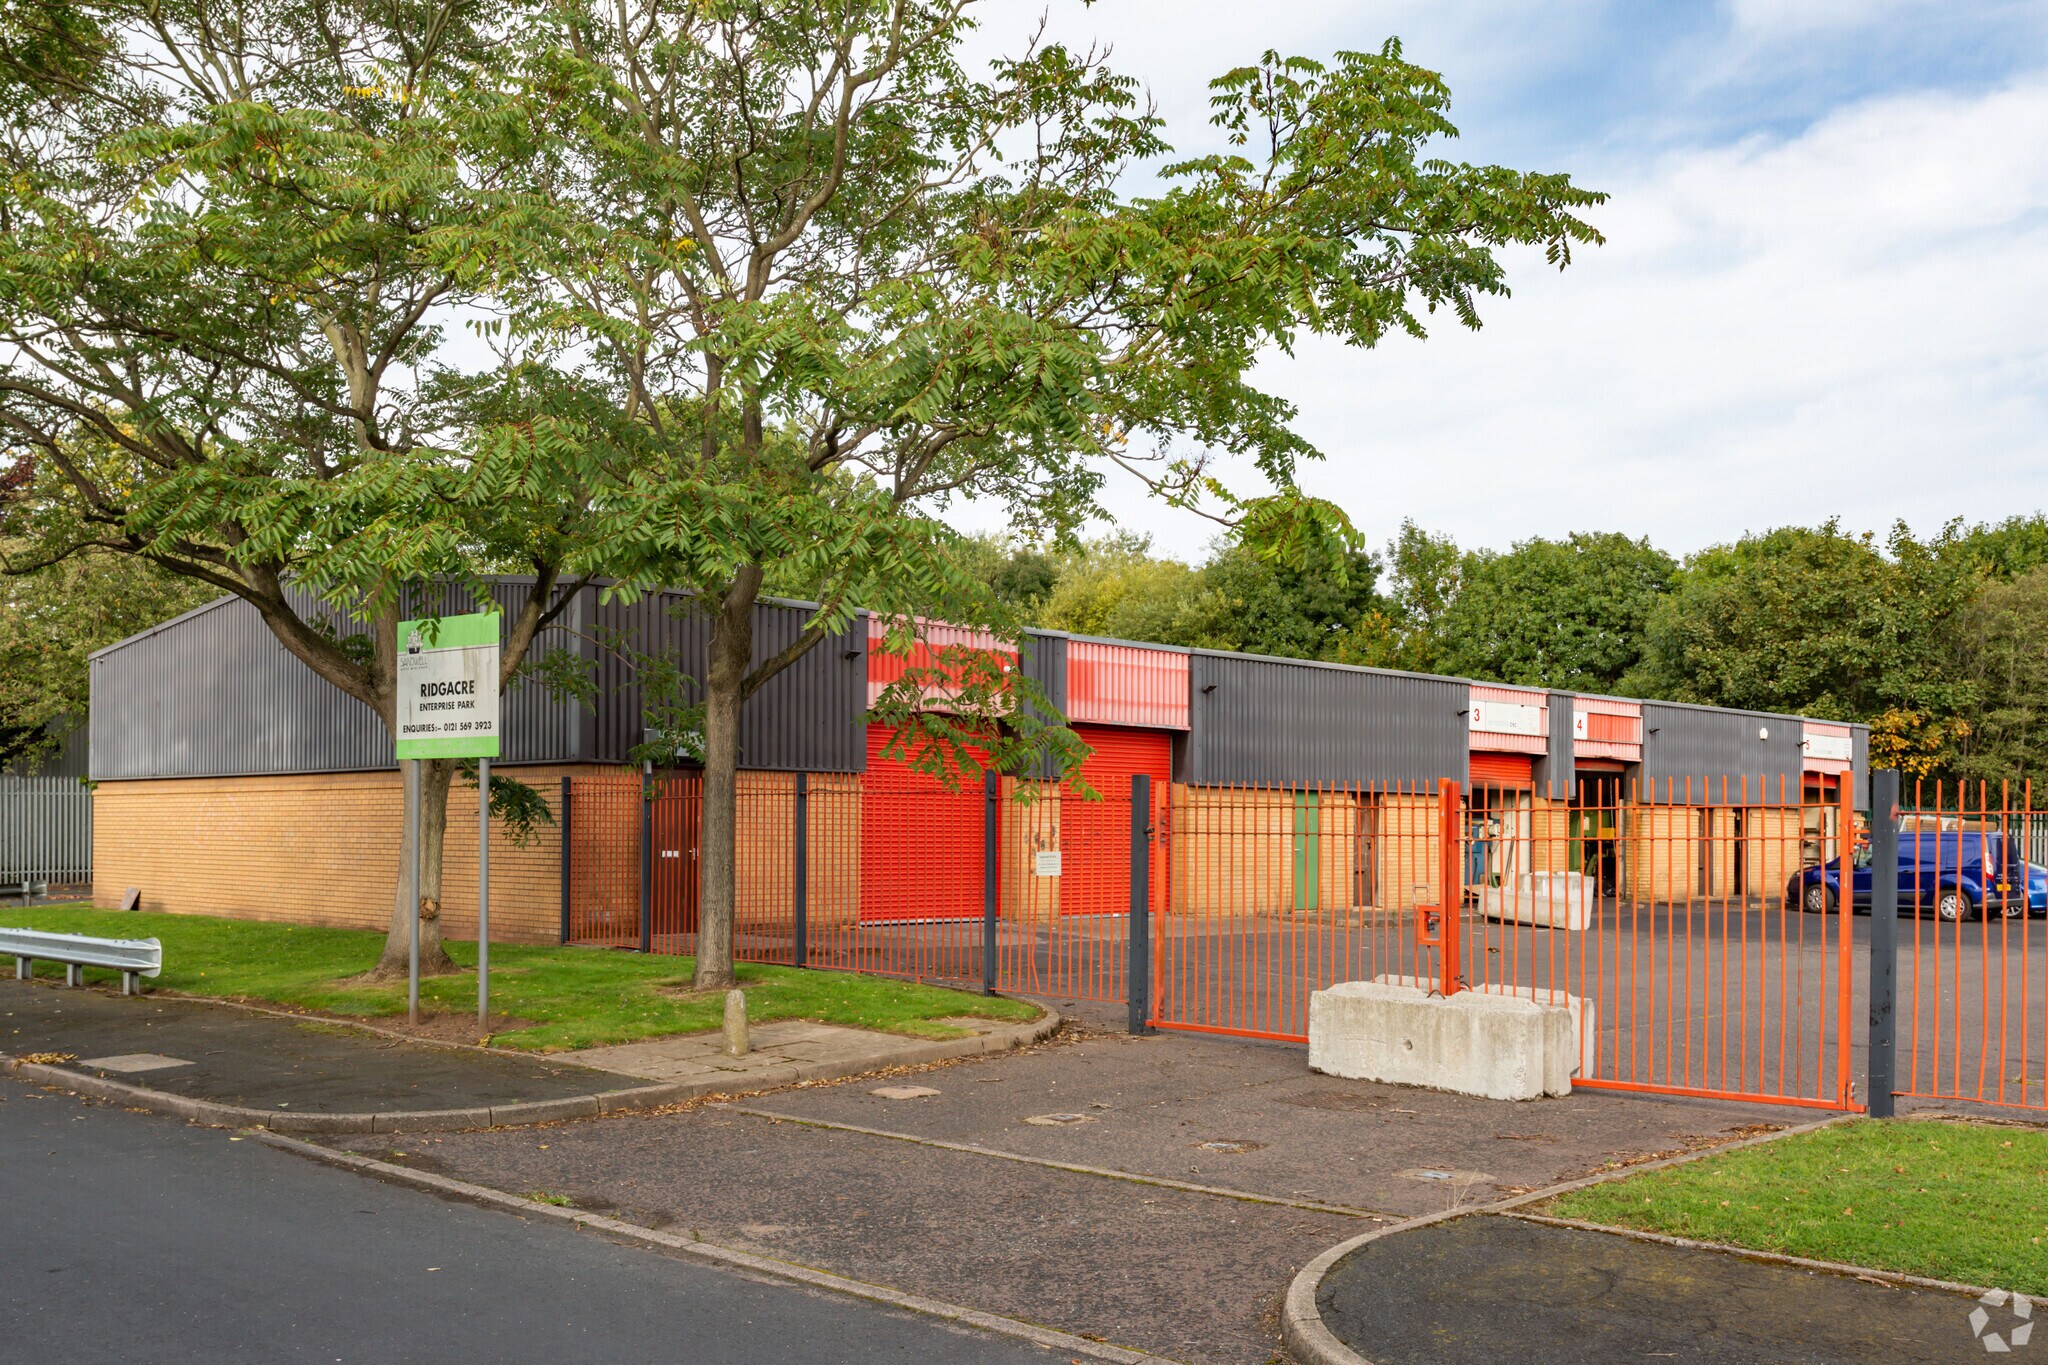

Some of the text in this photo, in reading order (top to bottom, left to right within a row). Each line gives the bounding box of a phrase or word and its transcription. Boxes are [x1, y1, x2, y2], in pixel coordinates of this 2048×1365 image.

[420, 680, 475, 698] RIDGACRE
[419, 700, 475, 712] ENTERPRISE PARK
[1473, 708, 1480, 722] 3
[443, 722, 458, 732] 0121
[459, 722, 473, 731] 569
[474, 720, 492, 730] 3923
[1576, 719, 1583, 731] 4
